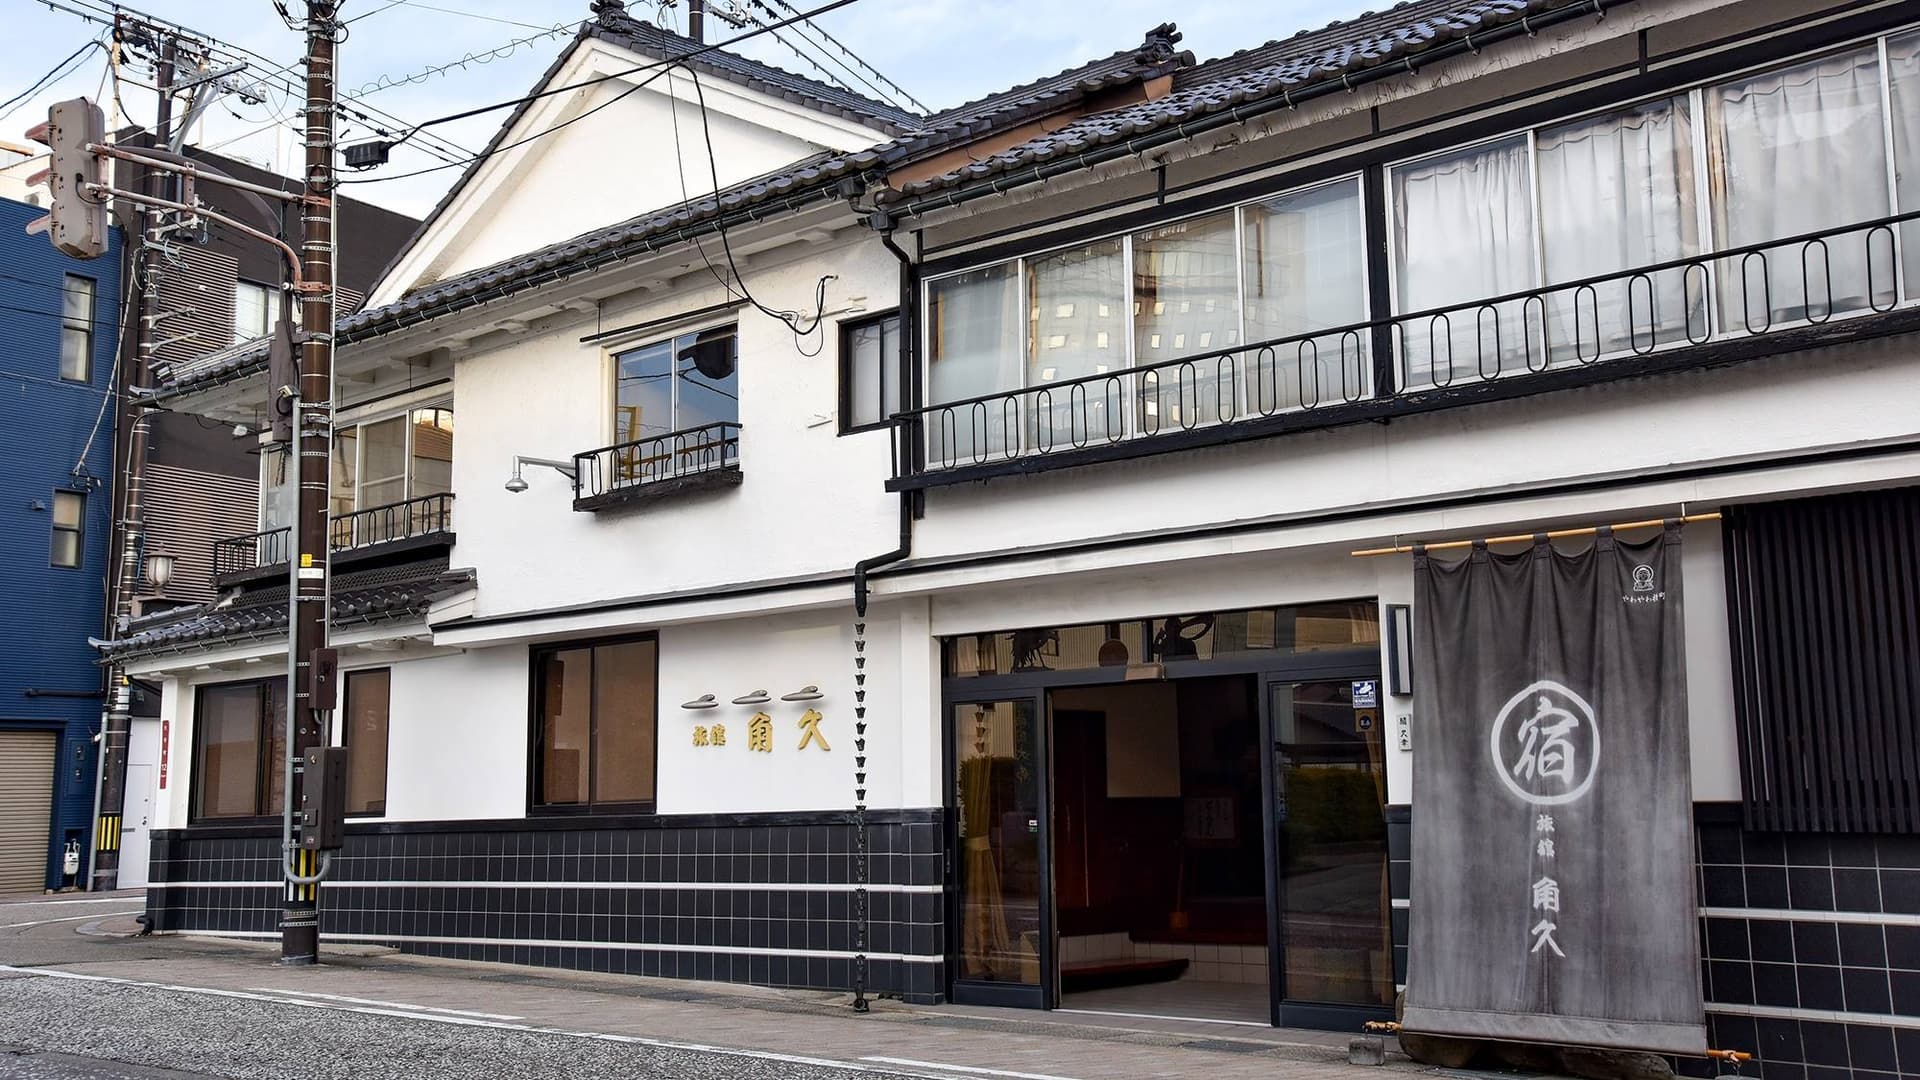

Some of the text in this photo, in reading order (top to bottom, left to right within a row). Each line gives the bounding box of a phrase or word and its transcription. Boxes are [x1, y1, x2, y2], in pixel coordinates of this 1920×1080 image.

[747, 707, 831, 753] 角久
[1514, 696, 1580, 785] 宿
[1531, 814, 1566, 958] 旅館 角久
